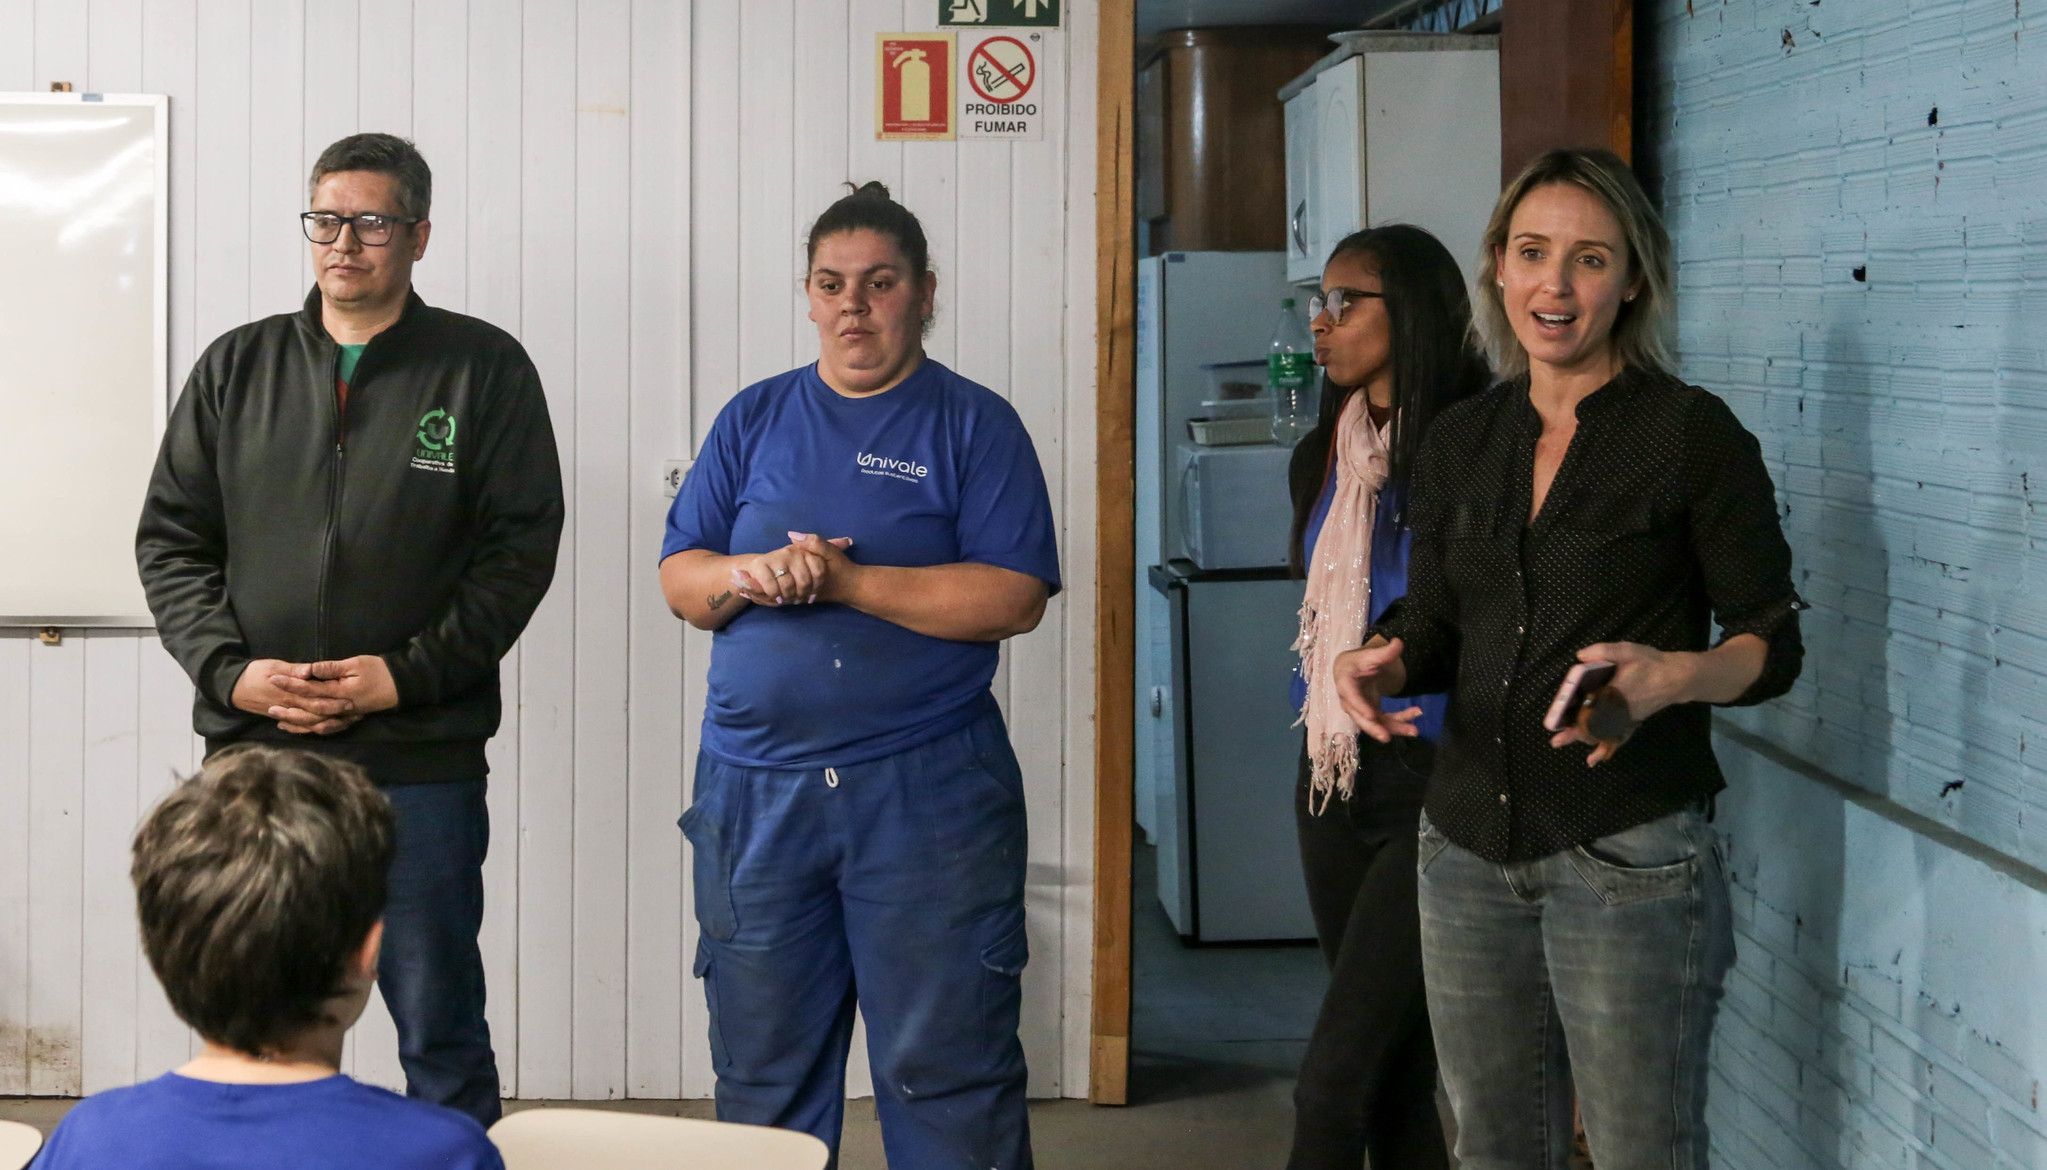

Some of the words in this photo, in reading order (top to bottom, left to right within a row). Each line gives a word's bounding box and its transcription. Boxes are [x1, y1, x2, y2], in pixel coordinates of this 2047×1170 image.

[965, 103, 1037, 116] PROIBIDO
[975, 121, 1027, 133] FUMAR
[857, 451, 928, 477] Univale
